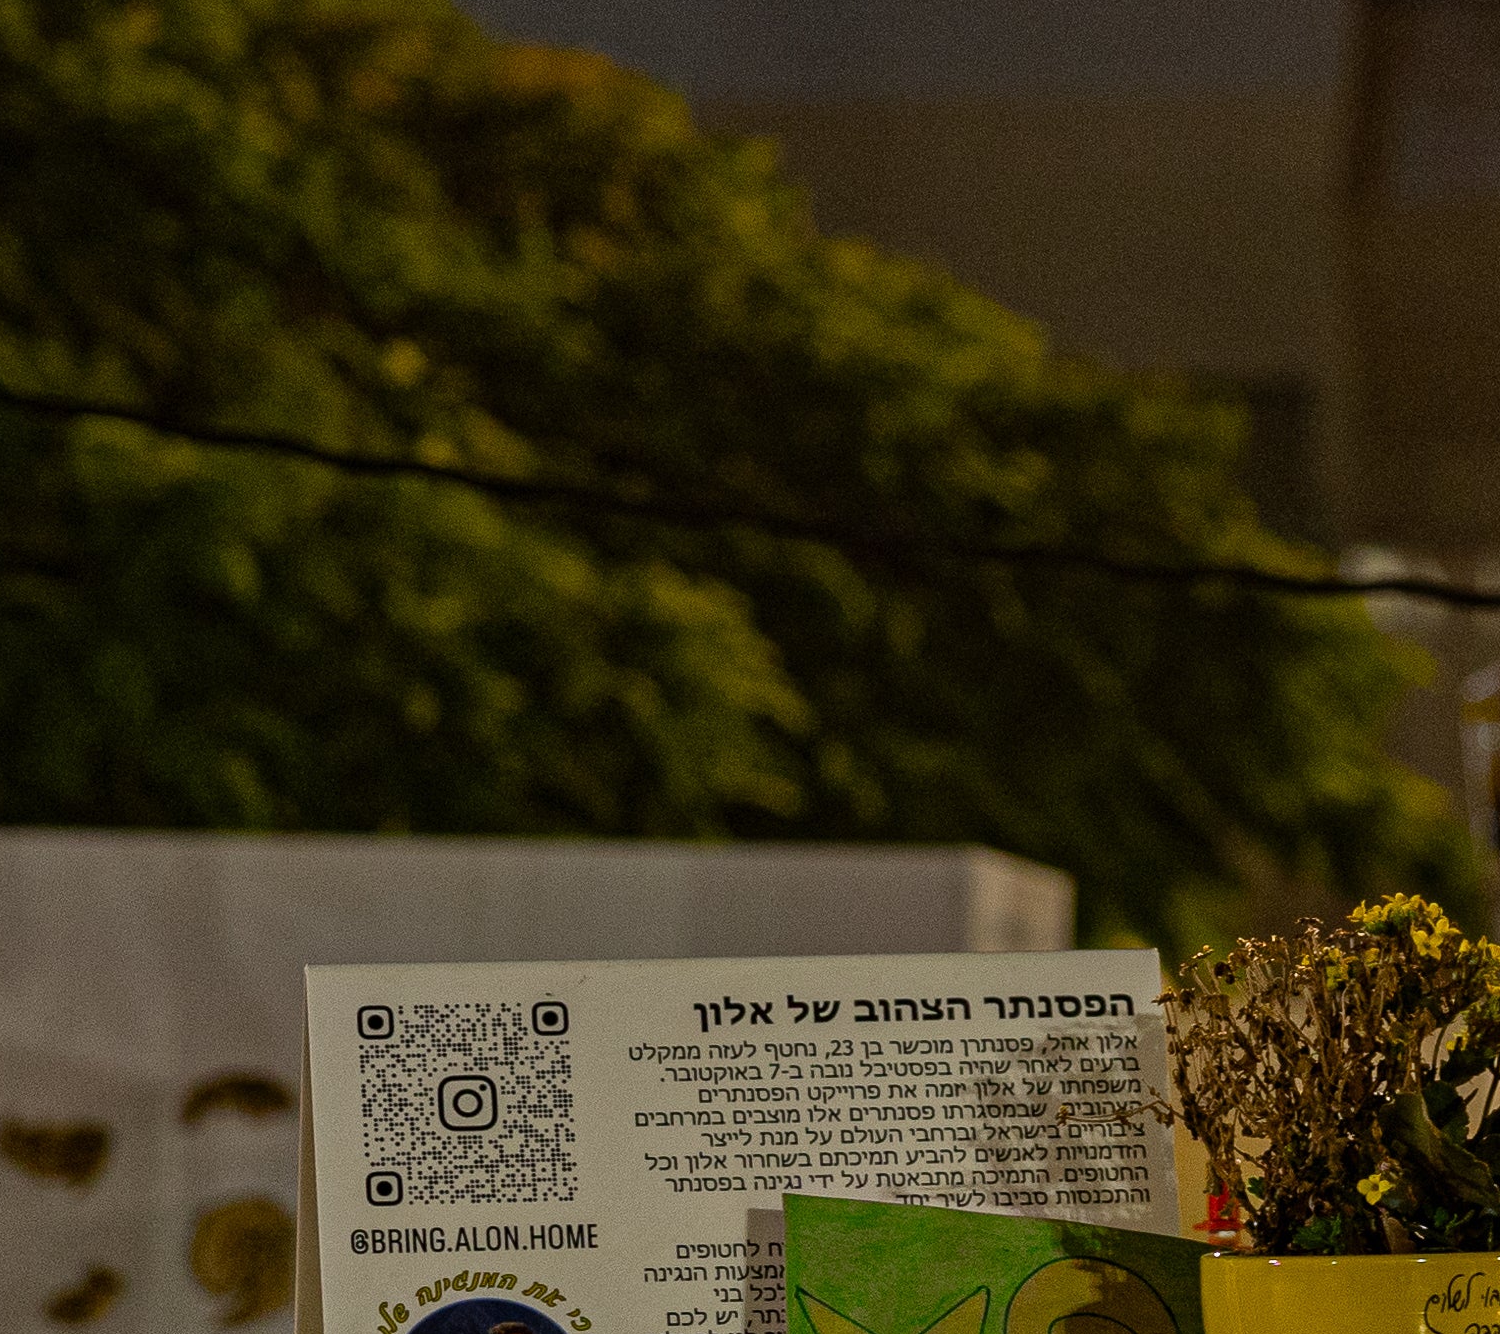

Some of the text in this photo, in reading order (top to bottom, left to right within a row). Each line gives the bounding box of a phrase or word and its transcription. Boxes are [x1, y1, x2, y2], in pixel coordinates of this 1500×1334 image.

[692, 992, 1135, 1037] הפסנתר הצהוב של אלון
[708, 1039, 756, 1058] לעזה
[860, 1040, 883, 1060] בן
[889, 1039, 953, 1054] מוכשר
[959, 1038, 1034, 1057] פסנתרן
[1039, 1032, 1089, 1056] אהל,
[1095, 1030, 1138, 1054] אלון
[763, 1042, 817, 1062] נחטף
[810, 1064, 853, 1079] נובה
[859, 1057, 952, 1077] בפסטיבל
[959, 1060, 1011, 1075] שהיה
[1016, 1054, 1072, 1073] לאחר
[1079, 1056, 1142, 1071] ברעים
[660, 1067, 762, 1087] באוקטובר.
[1021, 1076, 1053, 1095] של
[1058, 1079, 1142, 1094] משפחתו
[698, 1087, 799, 1102] הפסנתרים
[887, 1083, 916, 1098] את
[972, 1077, 1015, 1101] אלון
[634, 1104, 1047, 1126] שבמסגרתו פסנתרים אלו מוצבים במרחבים
[700, 1126, 752, 1146] לייצר
[759, 1130, 798, 1145] מנת
[804, 1125, 832, 1144] על
[840, 1124, 902, 1143] העולם
[908, 1127, 977, 1142] וברחבי
[982, 1121, 1060, 1140] בישראל
[644, 1151, 678, 1170] וכל
[734, 1152, 812, 1167] בשחרור
[819, 1150, 898, 1165] תמיכתם
[905, 1144, 966, 1164] להביע
[974, 1142, 1048, 1162] לאנשים
[684, 1150, 726, 1174] אלון
[664, 1176, 746, 1191] בפסנתר
[753, 1174, 802, 1189] נגינה
[808, 1173, 834, 1188] ידי
[840, 1168, 868, 1187] על
[972, 1169, 1050, 1184] התמיכה
[937, 1187, 986, 1207] לשיר
[990, 1191, 1048, 1206] סביבו
[1055, 1190, 1151, 1205] והתכנסות
[350, 1223, 599, 1254] @BRING.ALON.HOME
[675, 1239, 760, 1259] לחטופים
[643, 1265, 708, 1283] הנגינה
[415, 1270, 518, 1306] המנגינה
[521, 1281, 568, 1308] את
[712, 1287, 744, 1303] בני
[567, 1308, 593, 1333] כי
[666, 1308, 739, 1326] יש לכם
